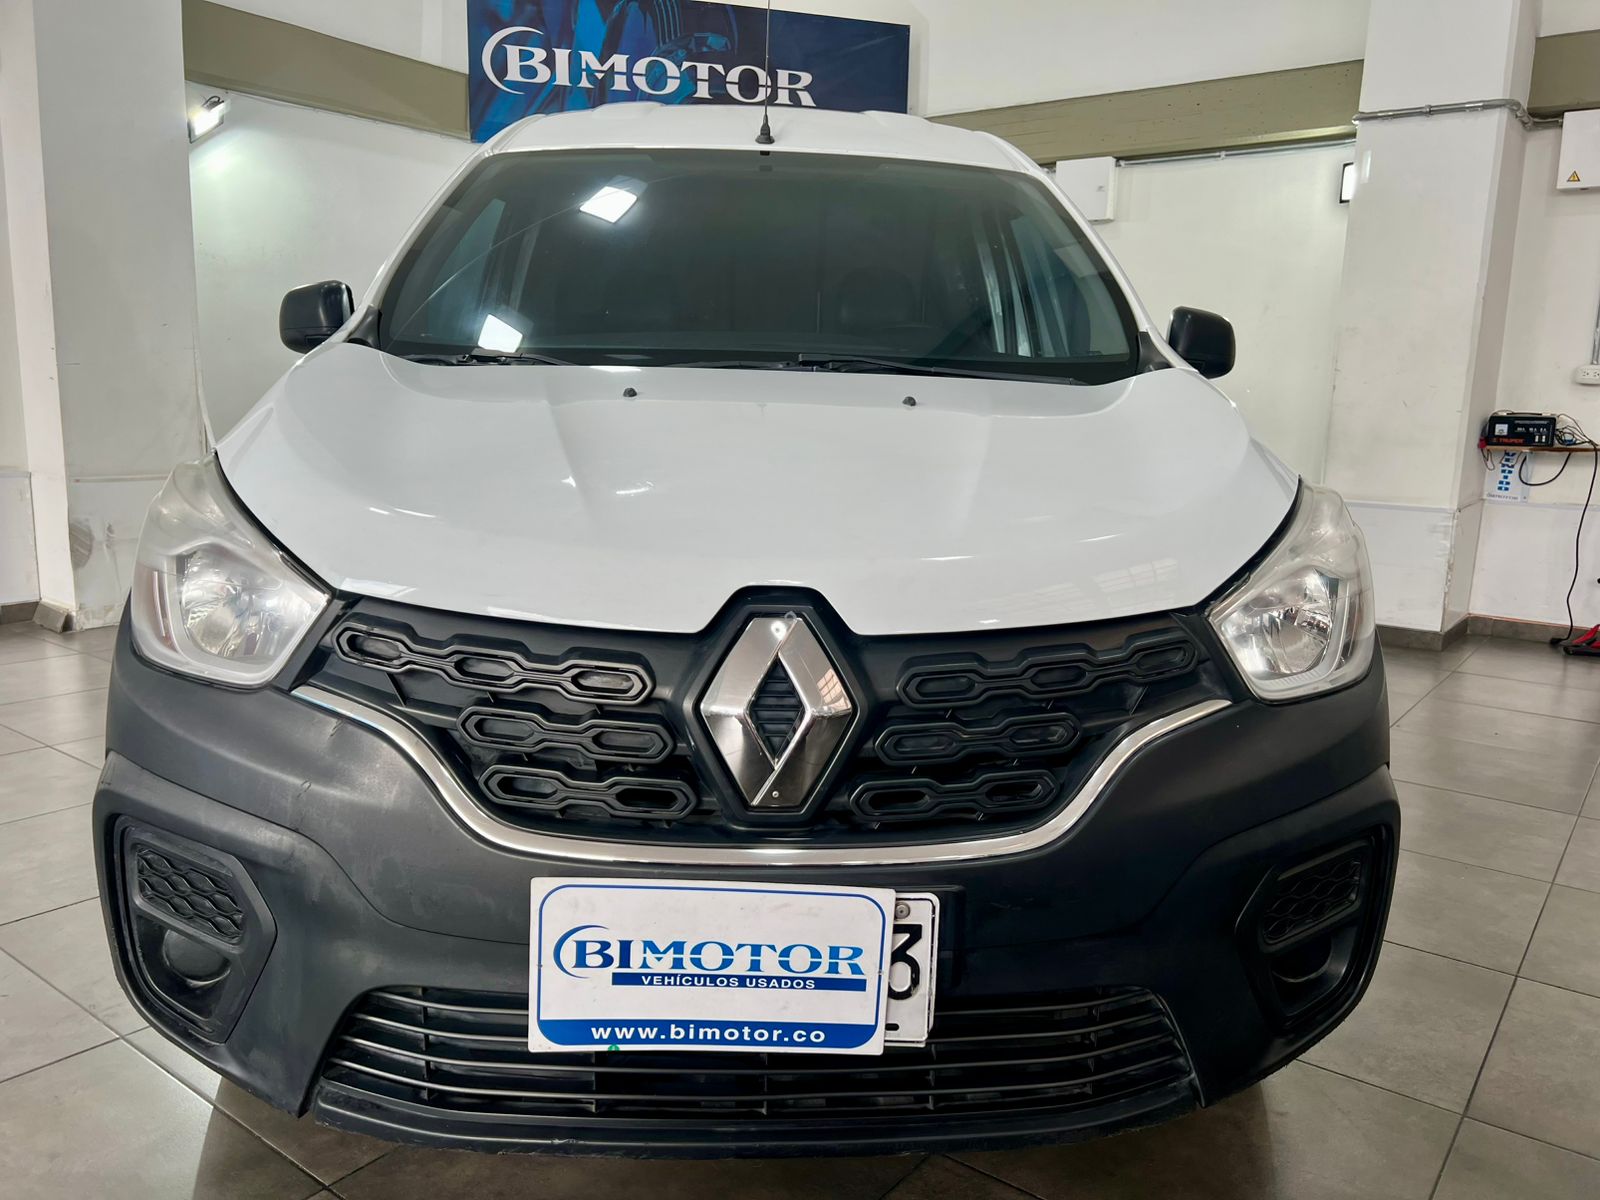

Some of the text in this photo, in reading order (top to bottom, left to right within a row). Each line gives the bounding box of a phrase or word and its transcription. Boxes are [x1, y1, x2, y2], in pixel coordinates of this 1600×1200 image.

[502, 44, 816, 107] BIMOTOR
[571, 939, 865, 976] BIMOTOR
[888, 924, 922, 1000] 3
[641, 973, 815, 989] VEHÍCULOS USADOS
[591, 1023, 826, 1043] www.bimotor.co
